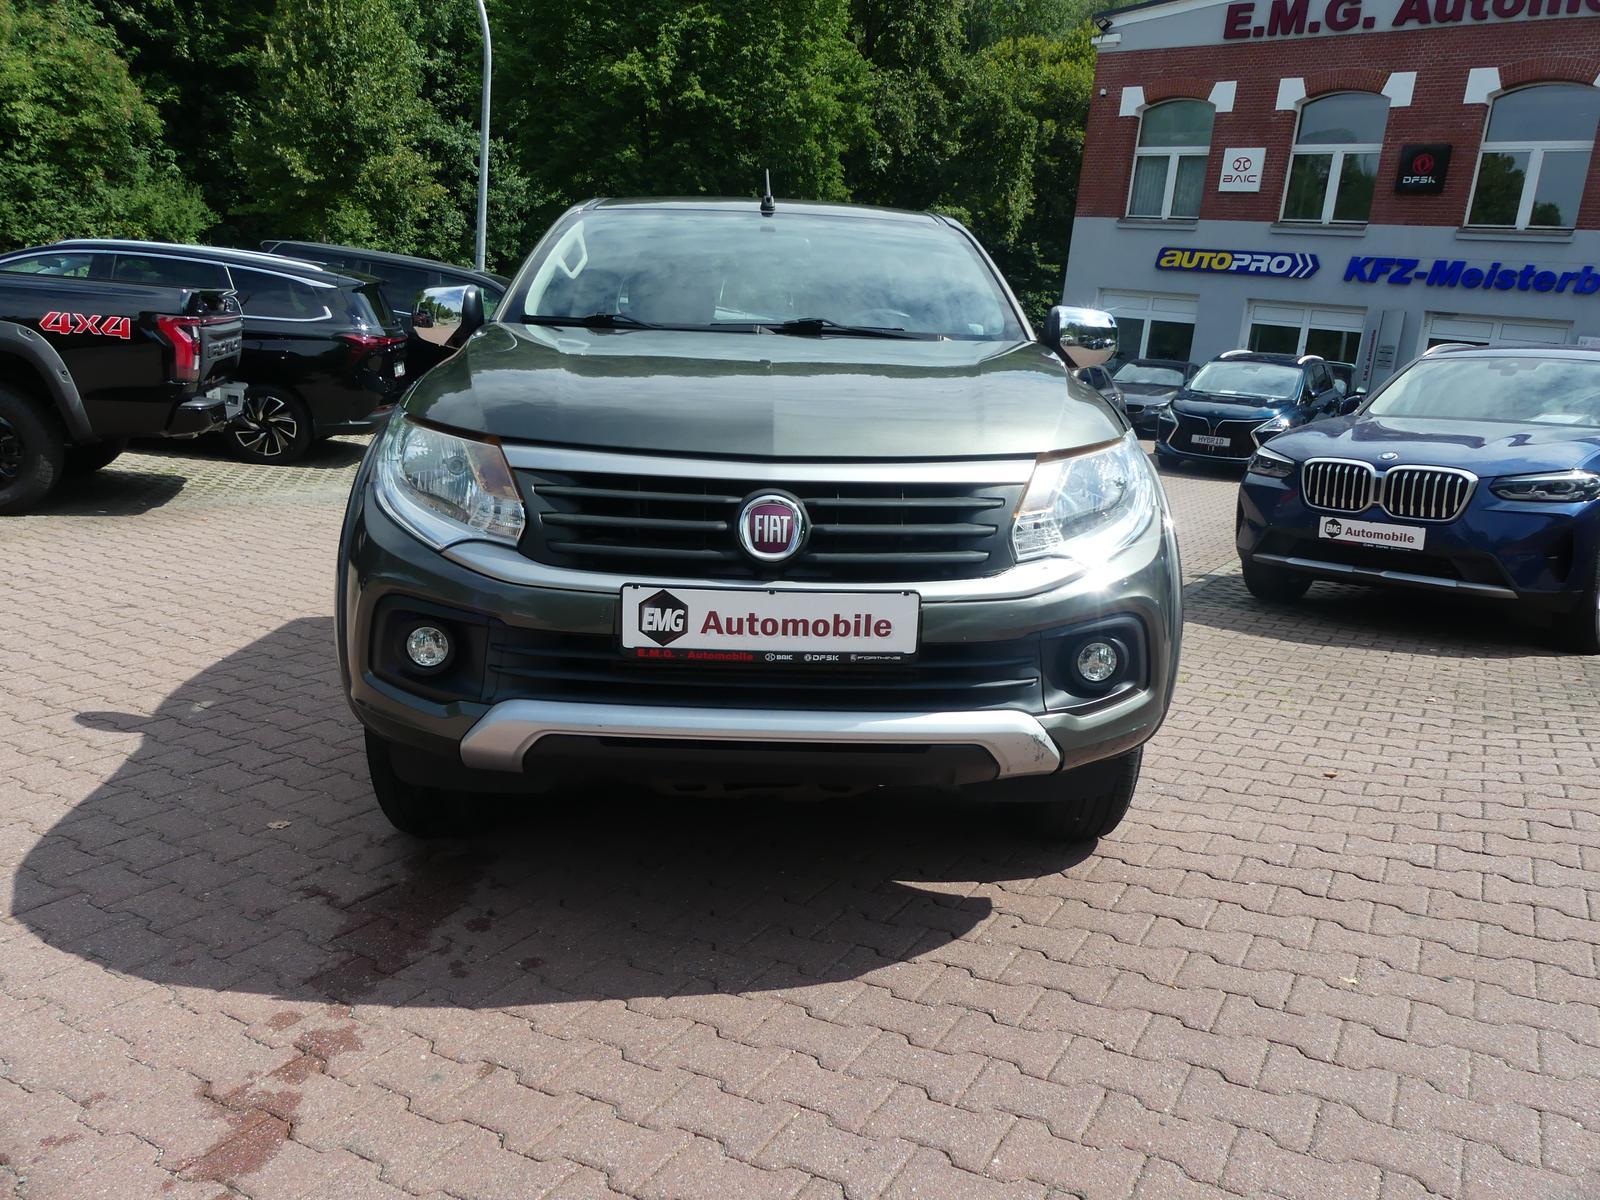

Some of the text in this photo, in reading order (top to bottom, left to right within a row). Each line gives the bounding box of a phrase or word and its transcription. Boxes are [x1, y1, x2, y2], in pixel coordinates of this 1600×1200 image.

[1224, 0, 1600, 39] E.M.G. Autom
[1223, 174, 1258, 184] BAIC
[1402, 176, 1437, 184] DFSK
[1343, 256, 1600, 295] KFZ-Meisterb
[1198, 436, 1225, 445] HYBRID
[754, 514, 791, 544] FIAT
[1326, 523, 1415, 543] EMG Automobile
[641, 607, 892, 638] EMG Automobile
[688, 651, 753, 662] Automobile
